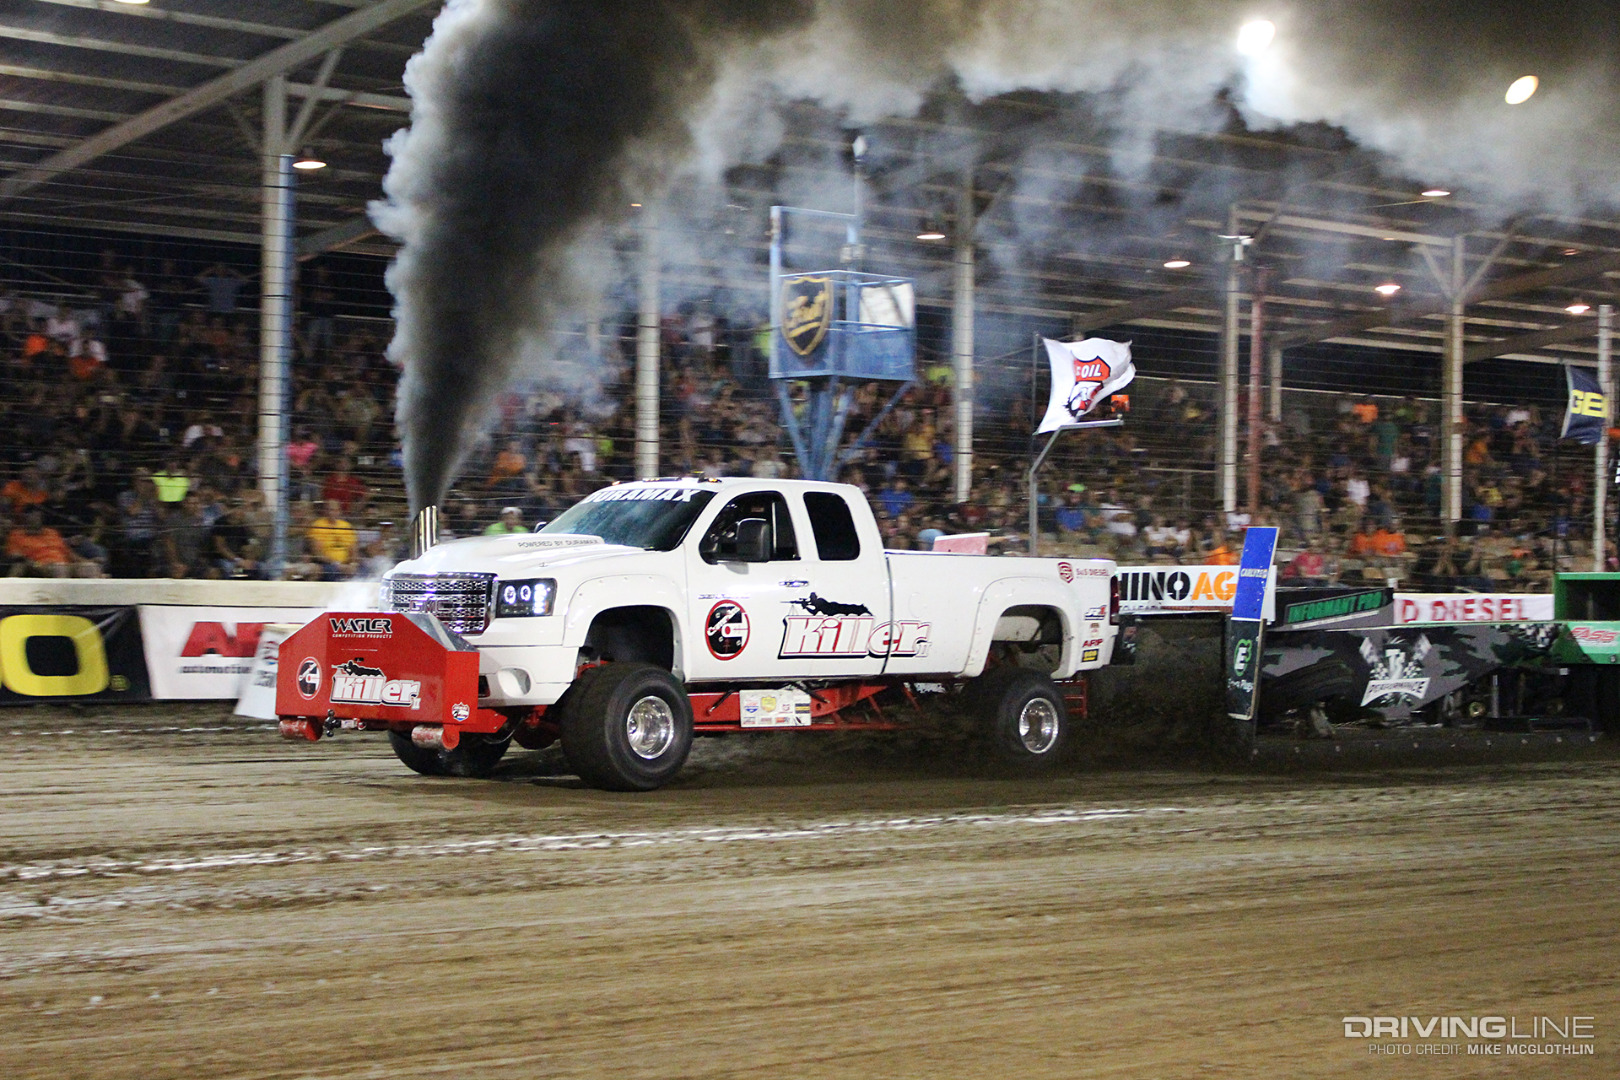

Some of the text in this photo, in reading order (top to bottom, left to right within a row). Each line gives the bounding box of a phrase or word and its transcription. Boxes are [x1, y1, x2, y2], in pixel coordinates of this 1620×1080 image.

[1081, 364, 1102, 379] OIL
[581, 489, 700, 504] DURAMAX
[1191, 571, 1238, 601] AG
[408, 598, 453, 613] GMC
[1432, 598, 1529, 621] DIESEL
[329, 618, 393, 633] WAGLER
[778, 614, 931, 660] Killer
[331, 675, 421, 706] Killer
